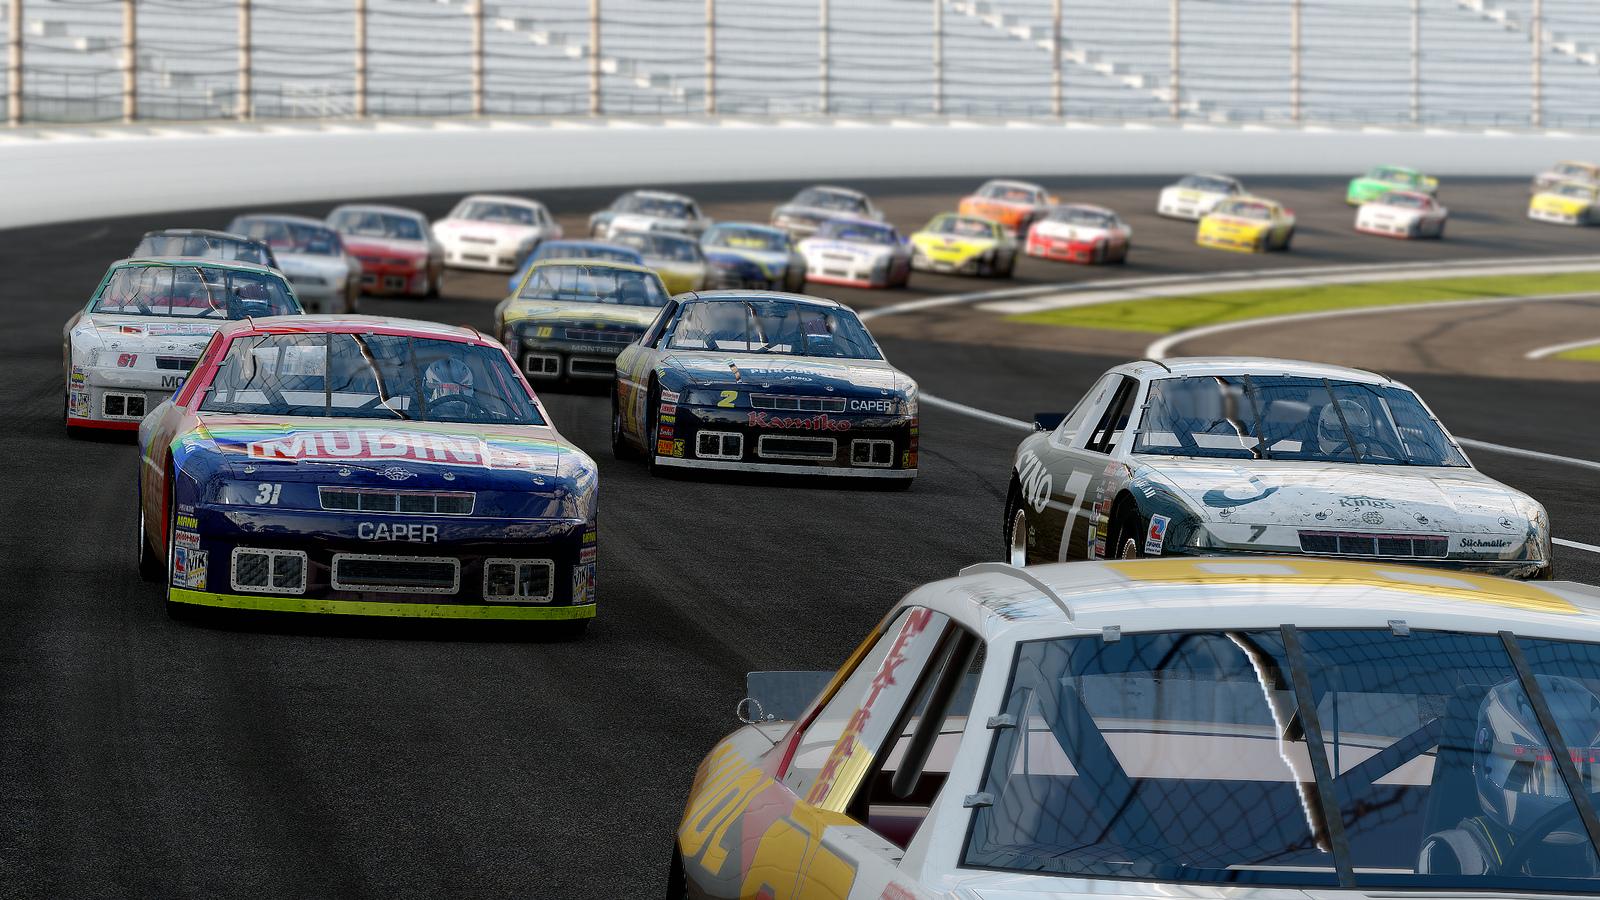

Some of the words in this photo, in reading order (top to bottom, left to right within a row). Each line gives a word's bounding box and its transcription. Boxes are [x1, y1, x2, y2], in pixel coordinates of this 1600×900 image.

[717, 390, 739, 408] 2
[850, 400, 892, 412] CAPER
[255, 483, 281, 505] 31
[1058, 467, 1093, 563] 7
[357, 522, 438, 543] CAPER
[1248, 525, 1267, 543] 7
